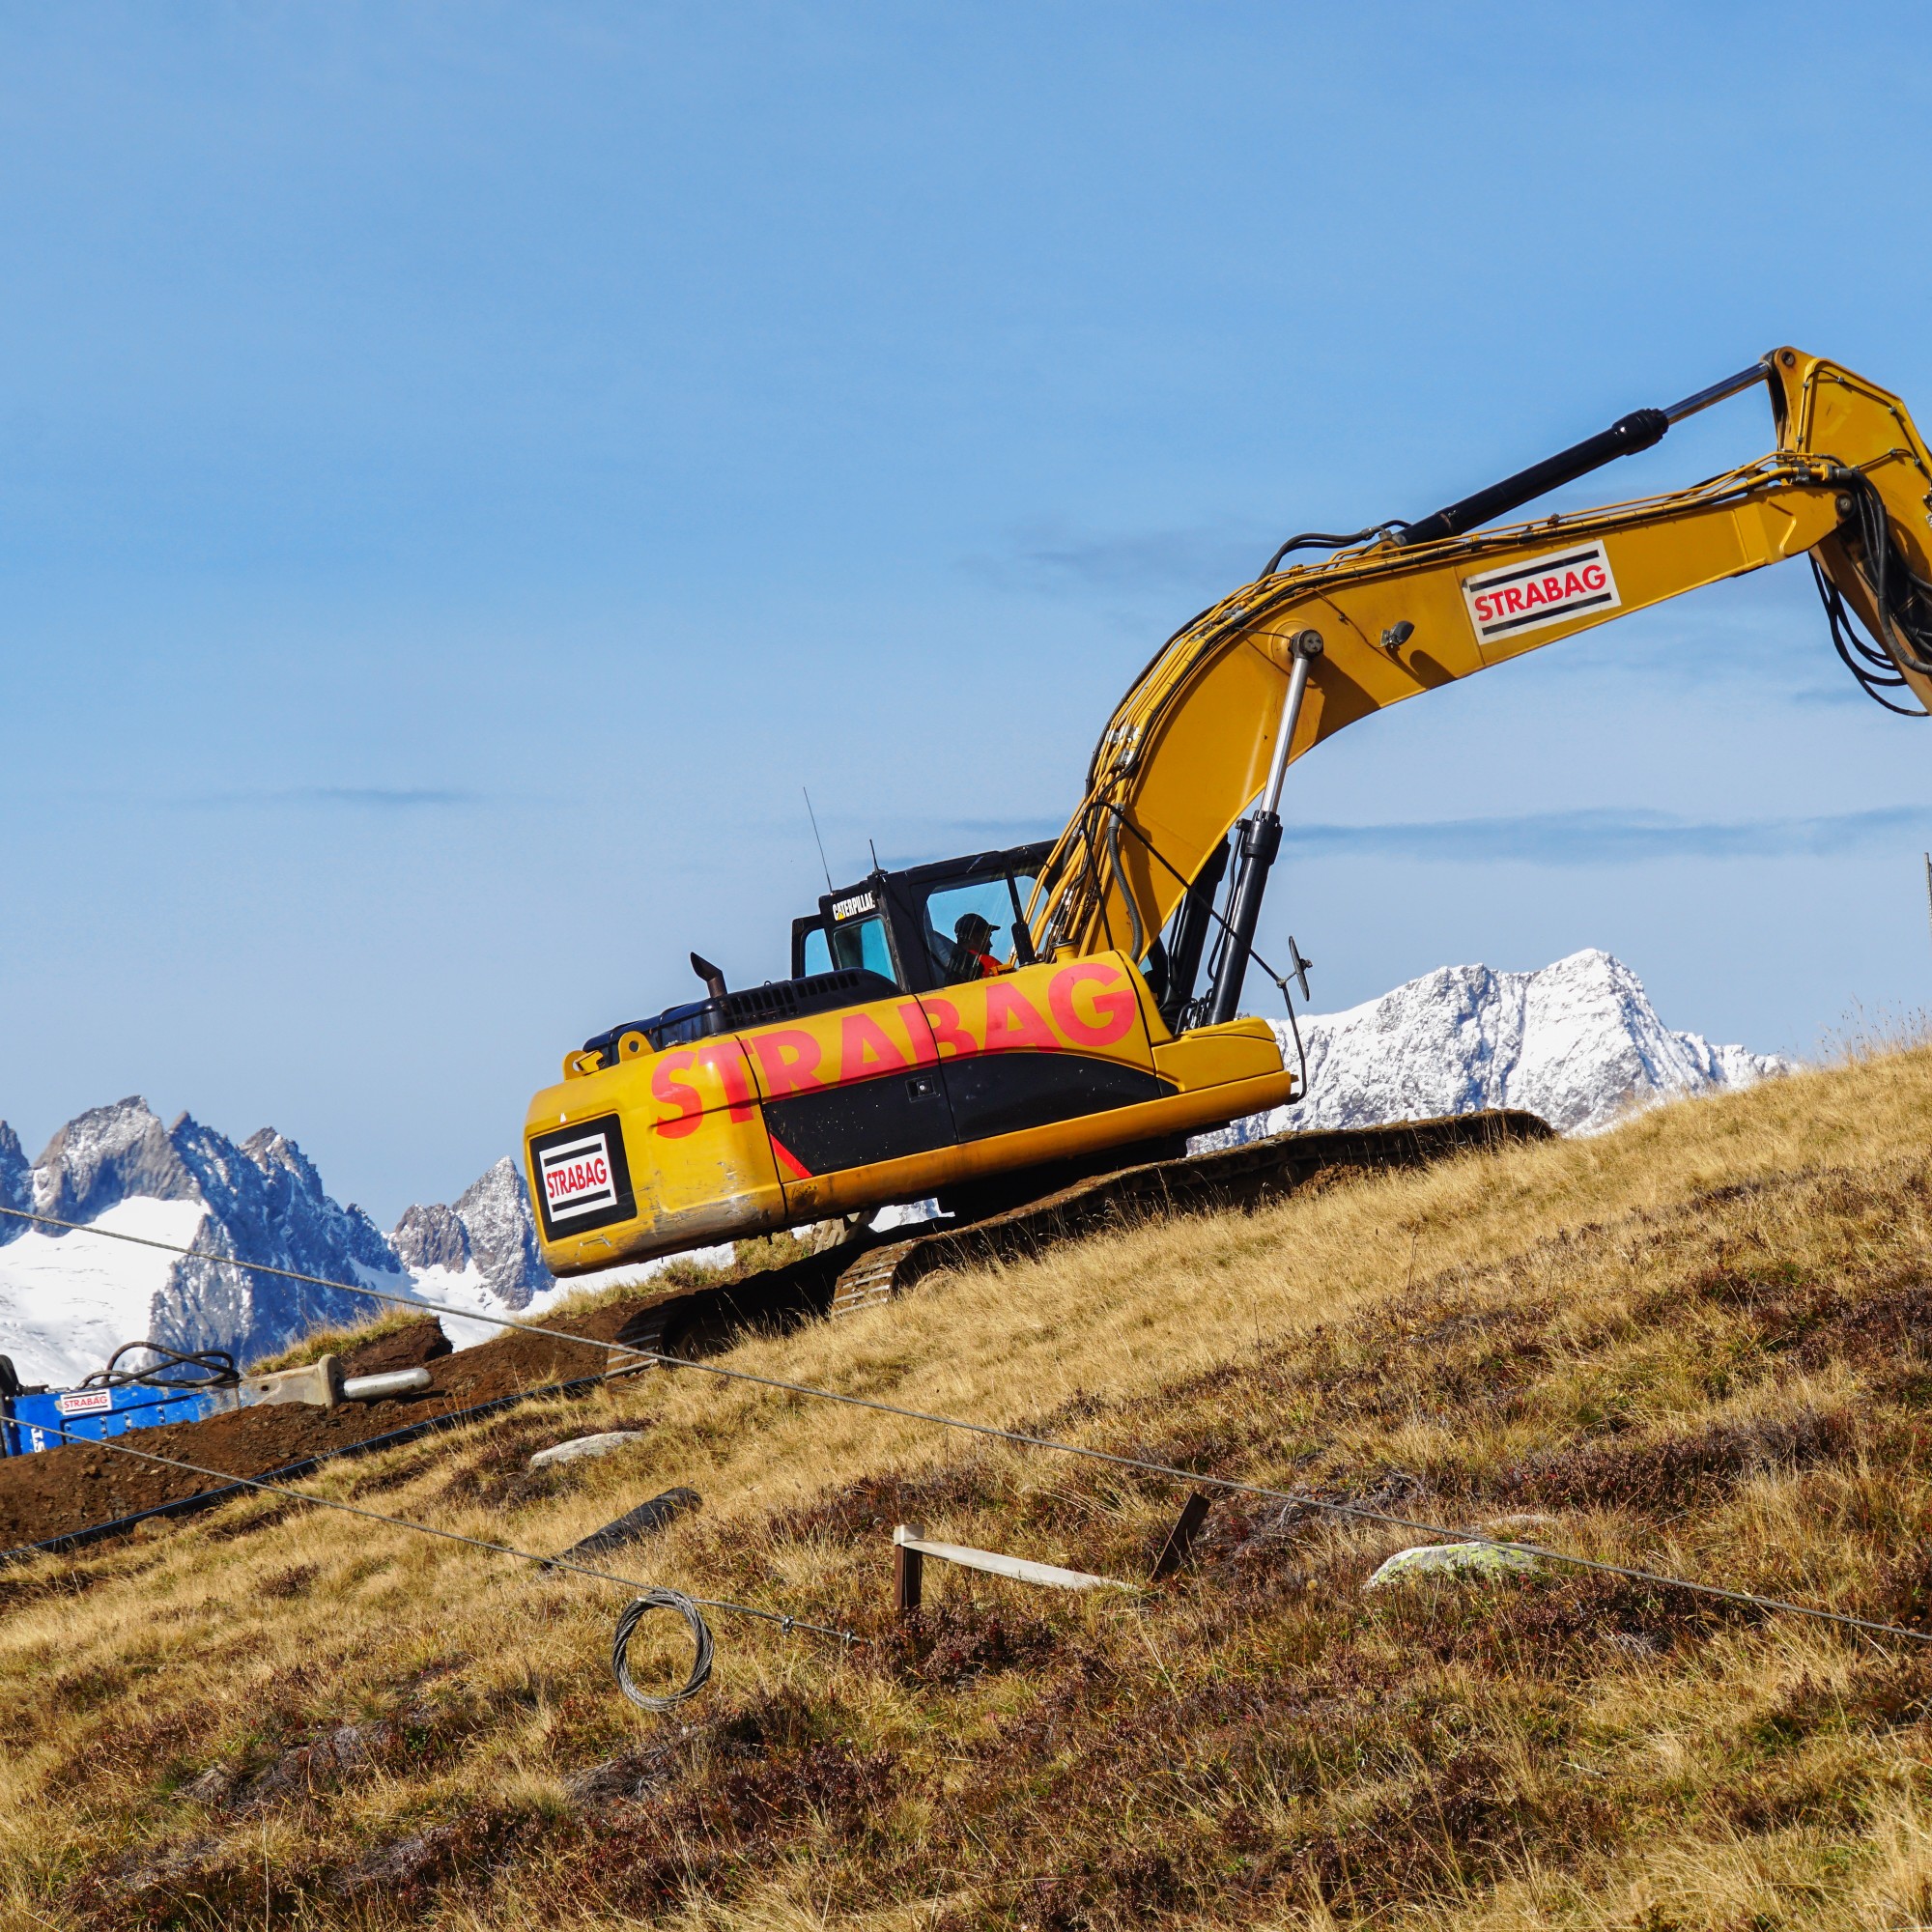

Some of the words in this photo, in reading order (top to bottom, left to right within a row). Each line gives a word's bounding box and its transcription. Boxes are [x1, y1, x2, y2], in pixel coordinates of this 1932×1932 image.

[1474, 564, 1606, 622] STRABAG
[650, 962, 1136, 1140] STRABAG
[546, 1157, 608, 1199] STRABAG
[64, 1395, 107, 1409] STRABAG
